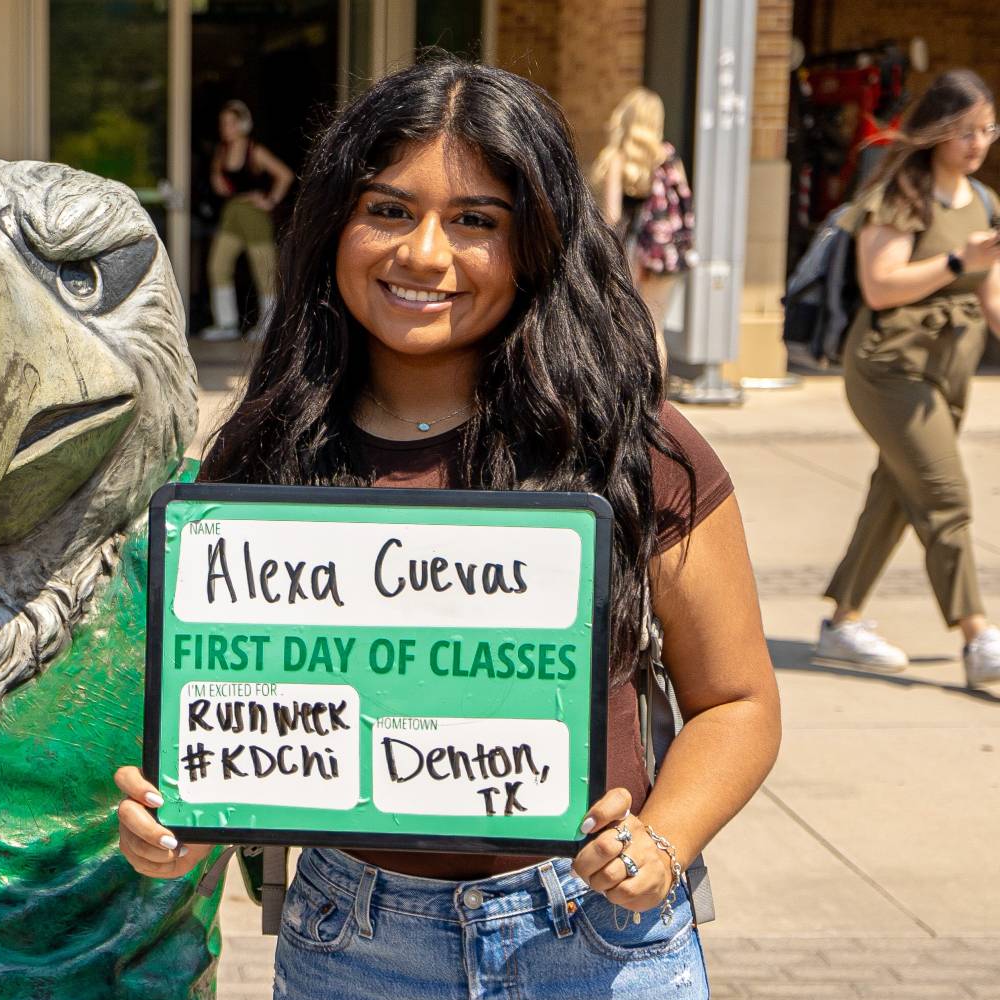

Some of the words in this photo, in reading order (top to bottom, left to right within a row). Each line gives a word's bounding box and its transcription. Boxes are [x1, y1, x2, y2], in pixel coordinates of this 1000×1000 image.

[189, 522, 221, 536] NAME
[206, 537, 345, 607] Alexa
[374, 538, 528, 598] Cuevas
[174, 634, 270, 671] FIRST
[283, 636, 356, 673] DAY
[369, 638, 416, 675] OF
[429, 640, 577, 681] CLASSES
[188, 683, 206, 697] I'M
[209, 683, 252, 697] EXCITED
[255, 683, 278, 697] FOR
[376, 717, 438, 730] HOMETOWN
[380, 736, 550, 784] Denton,
